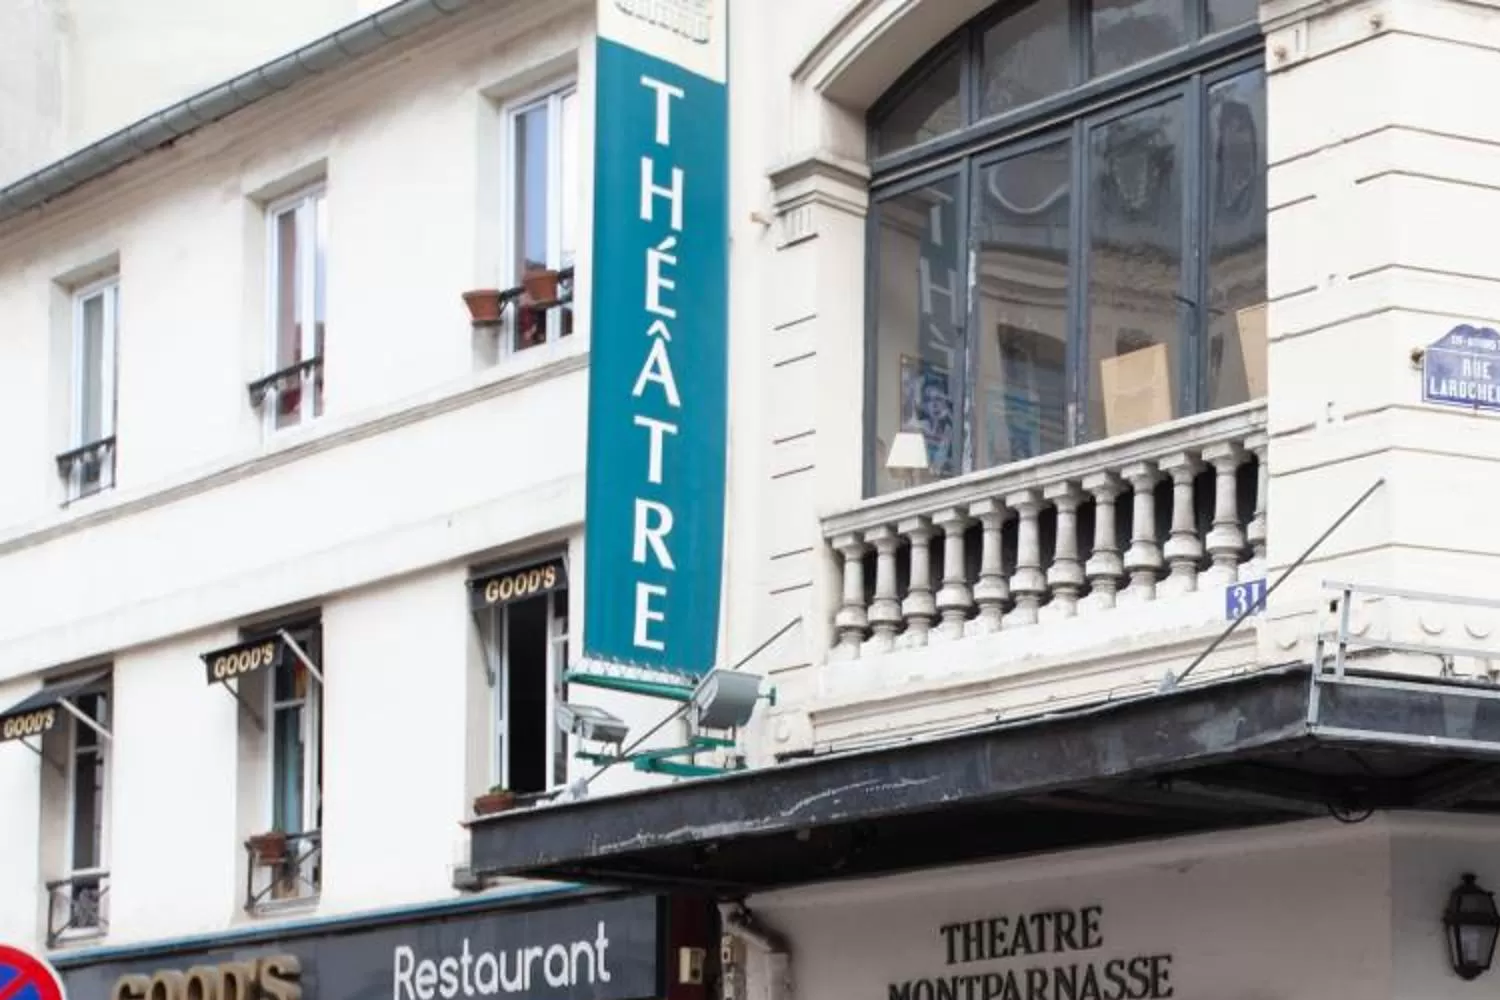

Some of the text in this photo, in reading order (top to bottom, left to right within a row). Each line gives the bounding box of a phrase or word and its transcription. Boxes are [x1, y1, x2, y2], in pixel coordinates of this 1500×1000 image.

[631, 75, 685, 652] THÉÂTRE
[1462, 358, 1493, 380] RUE
[485, 564, 556, 603] GOOD'S
[213, 642, 274, 679] GOOD'S
[3, 709, 56, 738] GOOD'S
[940, 905, 1104, 966] THEATRE
